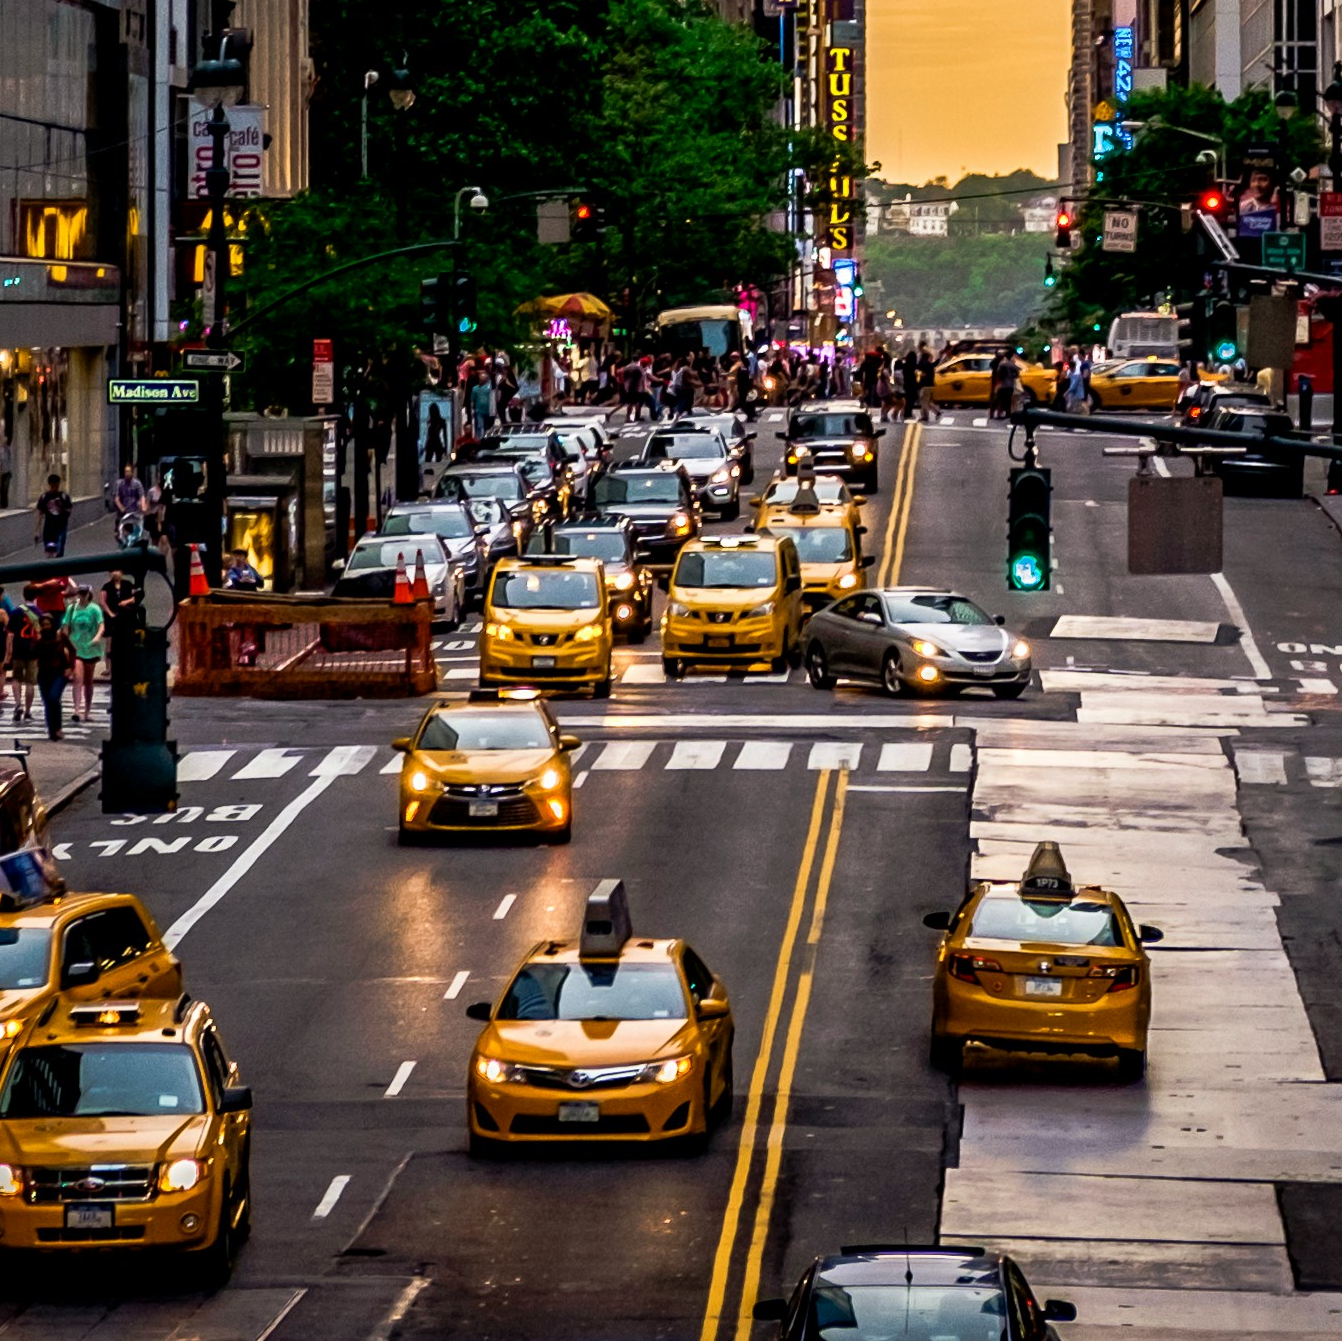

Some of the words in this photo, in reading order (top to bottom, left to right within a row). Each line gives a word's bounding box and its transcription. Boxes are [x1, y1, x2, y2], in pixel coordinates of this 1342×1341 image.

[230, 128, 259, 146] café
[1111, 217, 1129, 229] NO
[1105, 230, 1134, 242] TURNS
[112, 385, 168, 400] Madison
[171, 386, 196, 400] Ave
[109, 804, 264, 825] BUS
